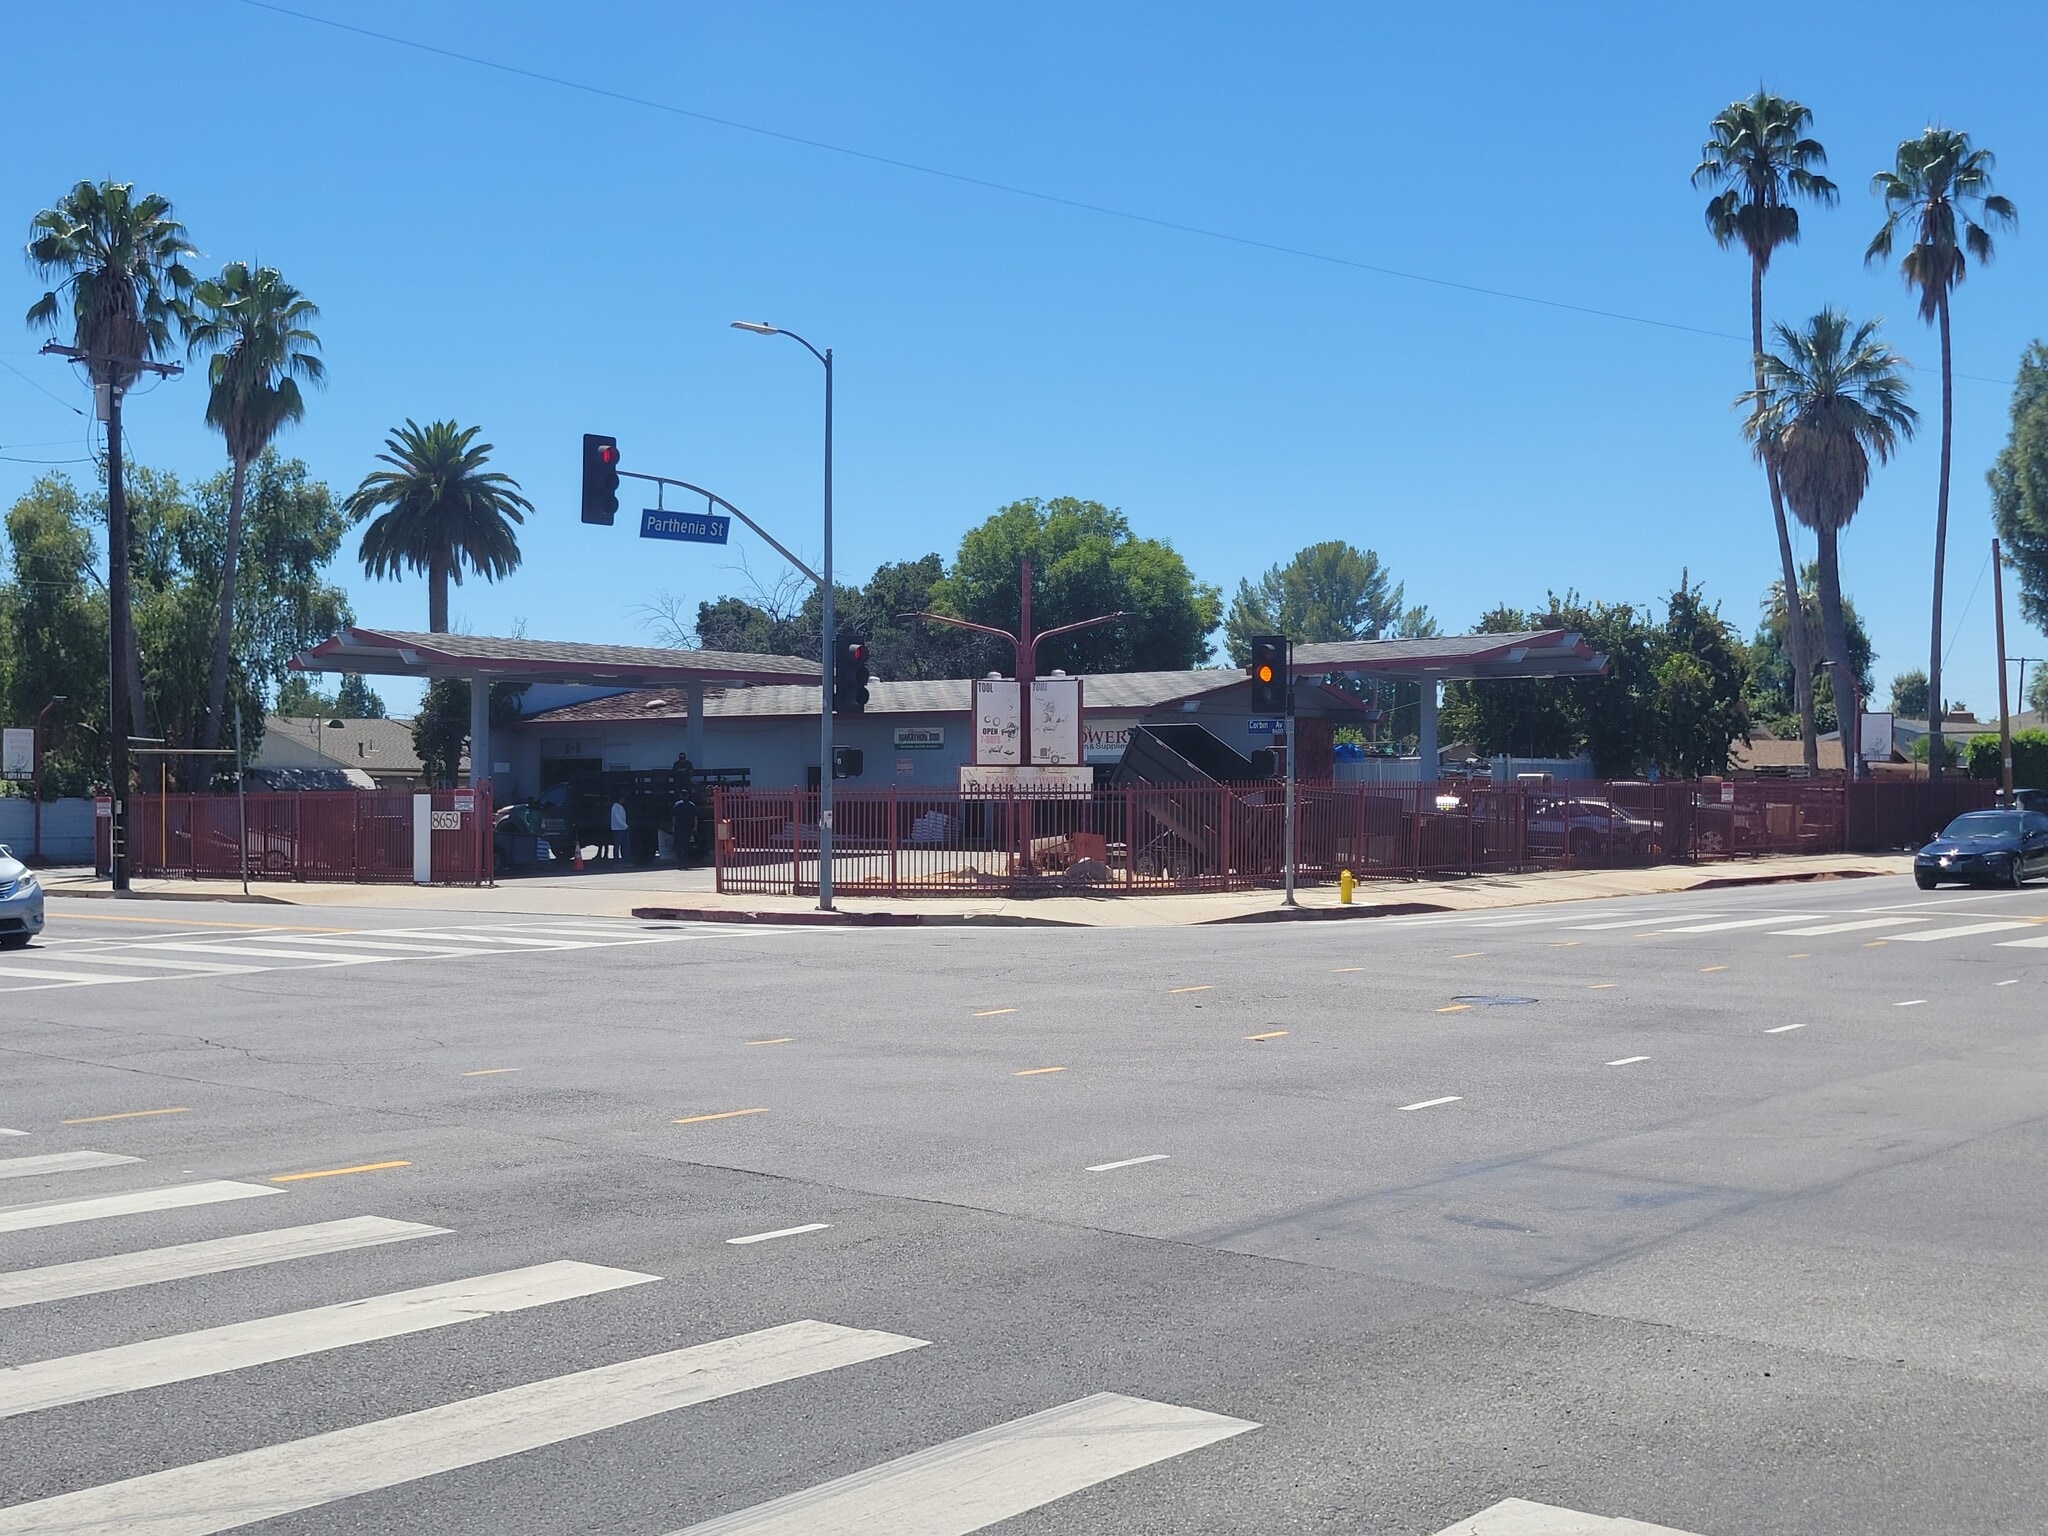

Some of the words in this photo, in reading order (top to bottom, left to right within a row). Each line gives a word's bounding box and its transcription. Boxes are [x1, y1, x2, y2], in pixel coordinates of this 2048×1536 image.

[647, 516, 706, 535] Parthenia
[710, 522, 724, 536] St
[978, 682, 993, 693] TOOL
[1249, 721, 1269, 729] Corbin
[1275, 721, 1284, 729] Av
[982, 727, 999, 736] OPEN
[432, 812, 459, 828] 8659
